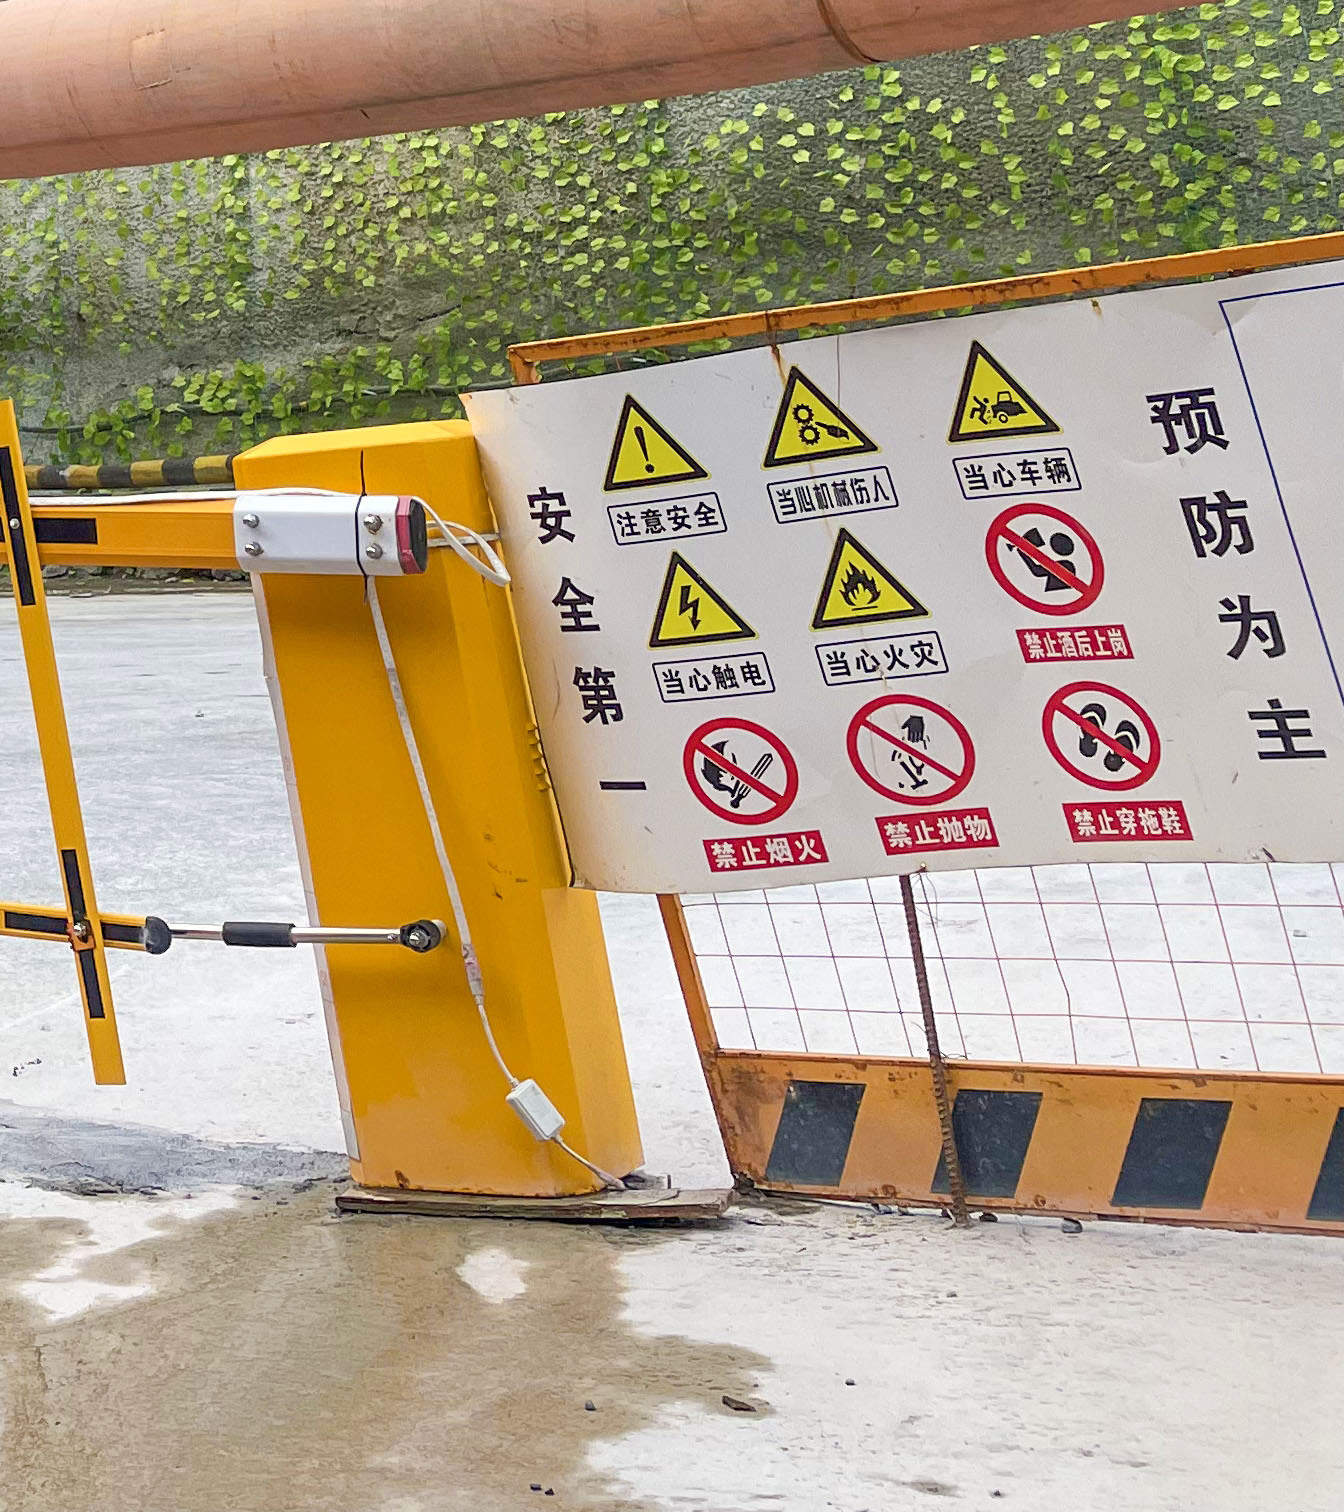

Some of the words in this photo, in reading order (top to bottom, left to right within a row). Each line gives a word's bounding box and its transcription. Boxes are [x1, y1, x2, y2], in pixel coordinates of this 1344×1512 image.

[964, 456, 1073, 491] 当心车辆
[776, 475, 890, 516] 当心机械伤人
[617, 502, 719, 537] 注意安全
[1146, 387, 1327, 760] 预防为主
[527, 487, 647, 790] 安全第一
[1024, 628, 1128, 659] 禁止酒后上岗
[826, 640, 940, 678] 当心火灾
[662, 661, 766, 695] 当心触电
[884, 816, 993, 849] 禁止抛物
[1073, 808, 1185, 837] 禁止穿拖鞋
[711, 835, 822, 869] 禁止烟火
